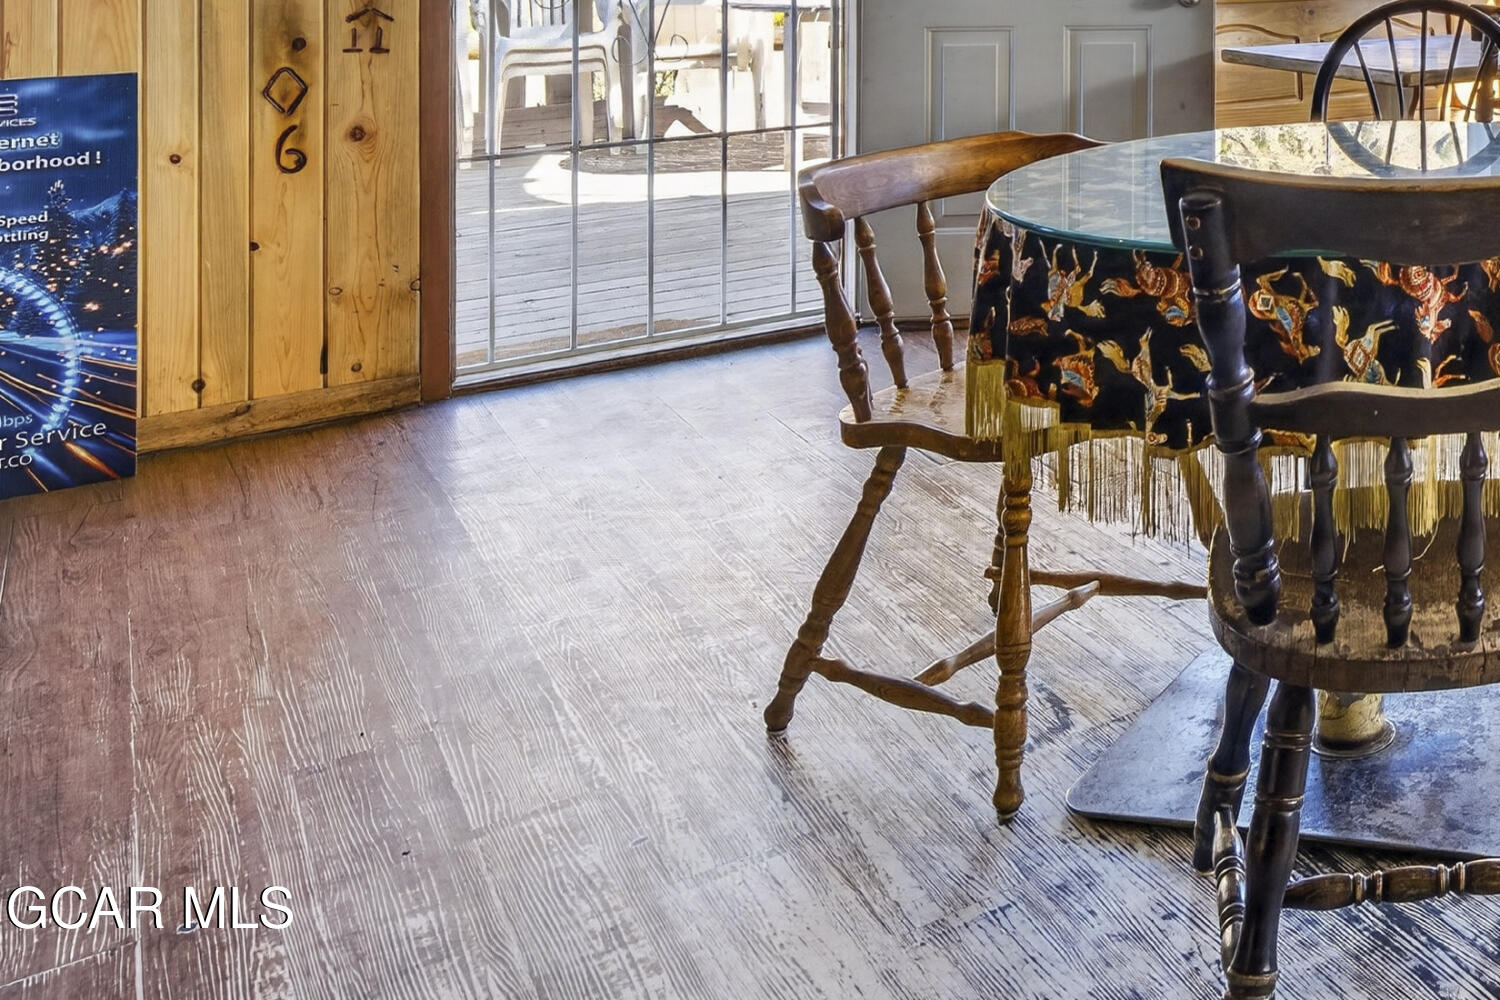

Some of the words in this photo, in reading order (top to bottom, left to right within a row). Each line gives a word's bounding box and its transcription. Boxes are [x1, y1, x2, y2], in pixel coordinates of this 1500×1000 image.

[0, 211, 48, 228] Speed
[0, 414, 33, 428] bps
[15, 422, 107, 449] Service
